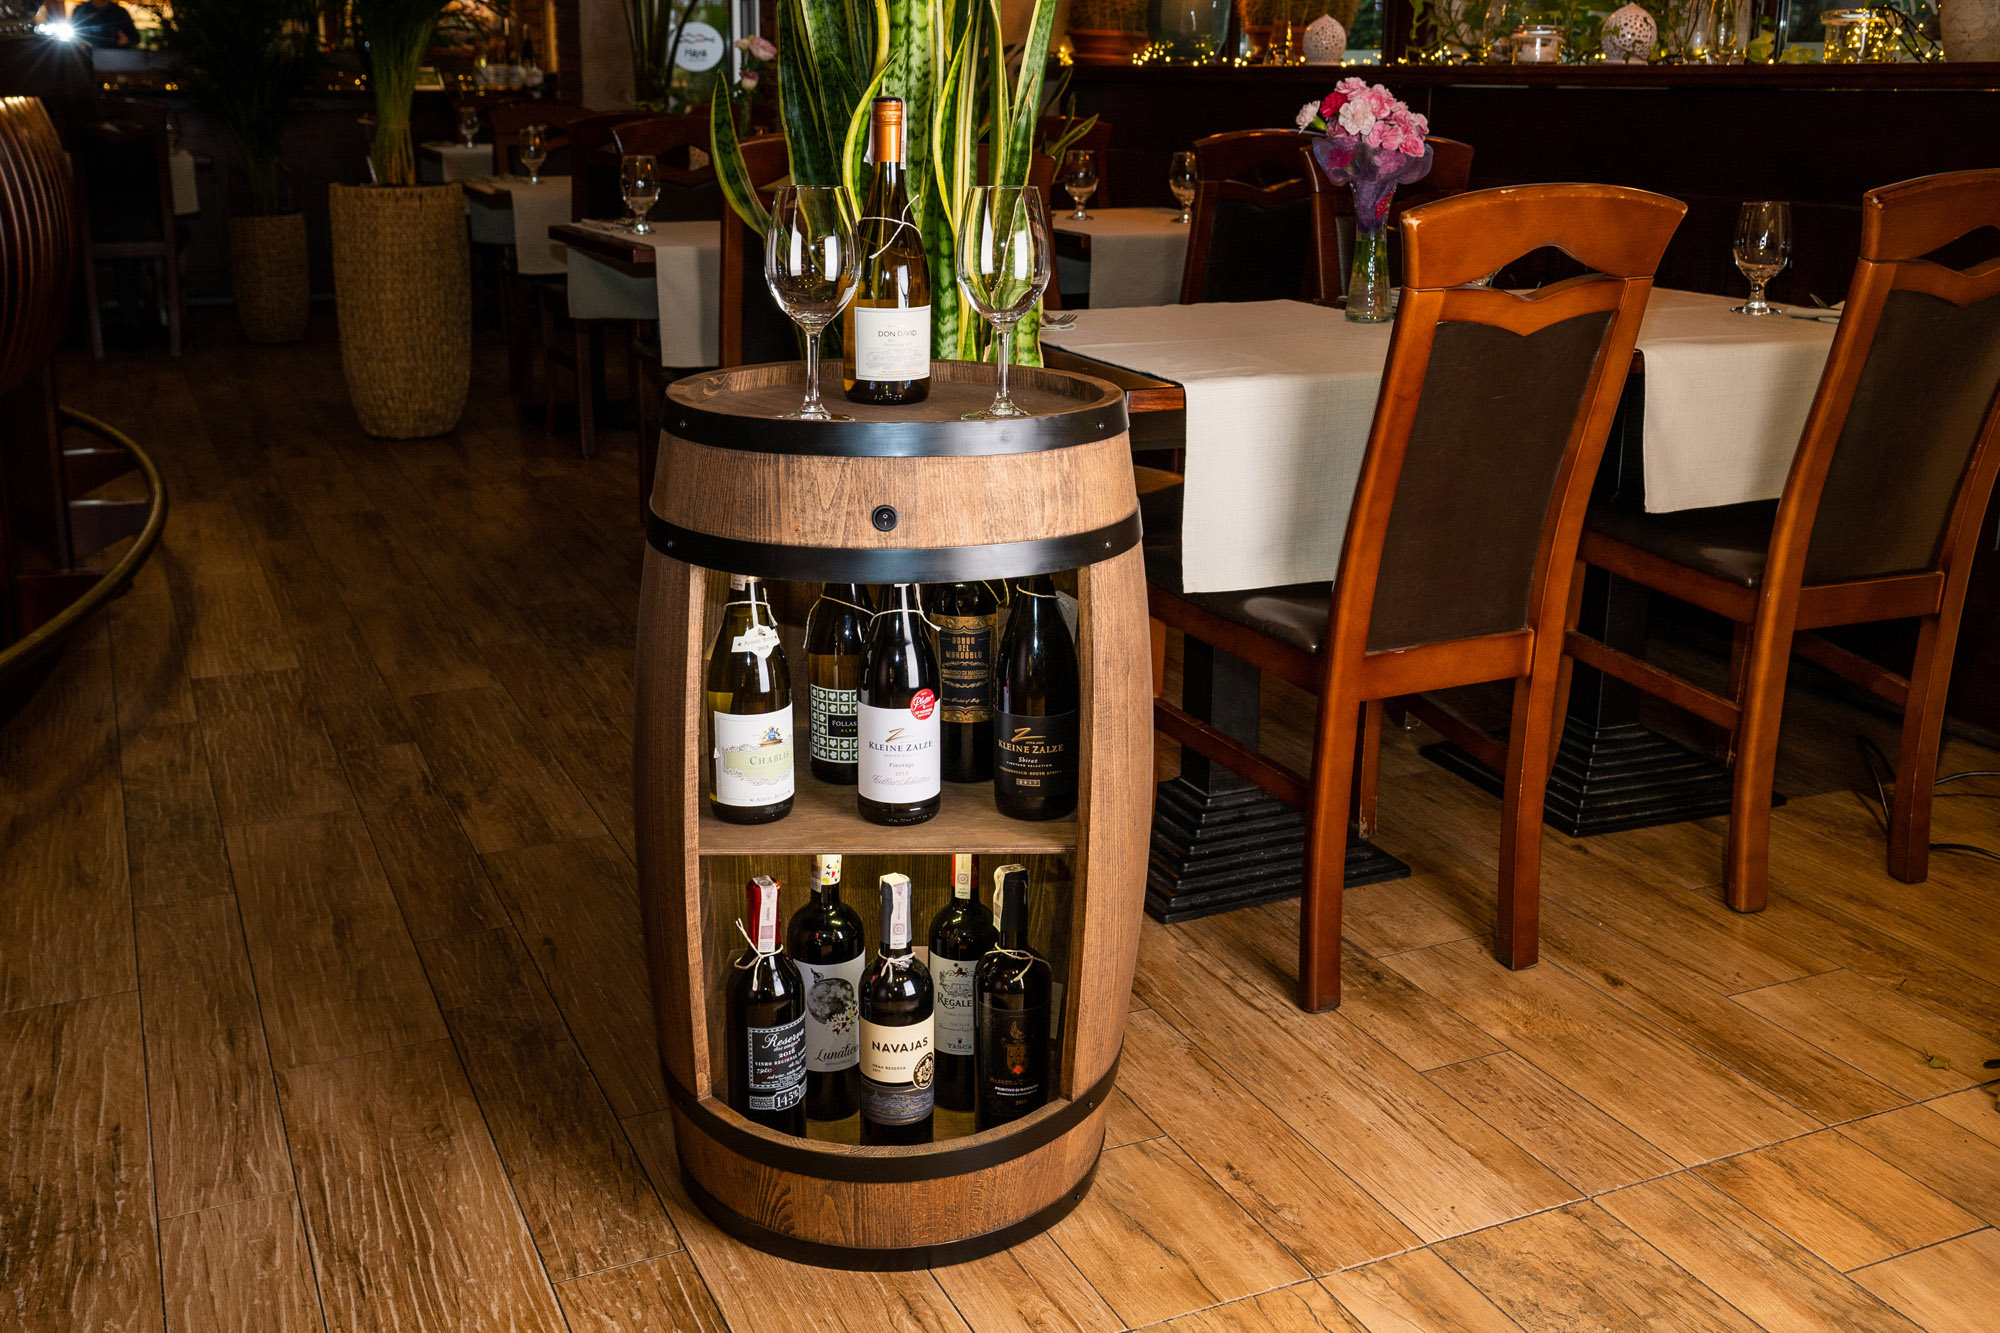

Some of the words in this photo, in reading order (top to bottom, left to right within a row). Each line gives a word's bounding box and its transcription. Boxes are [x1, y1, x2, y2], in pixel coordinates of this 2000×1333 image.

[868, 741, 903, 753] KLEINE
[906, 740, 933, 752] ZALZE
[998, 739, 1030, 754] KLEINE
[1032, 744, 1064, 754] ZALZE
[872, 1036, 928, 1053] NAVAJAS
